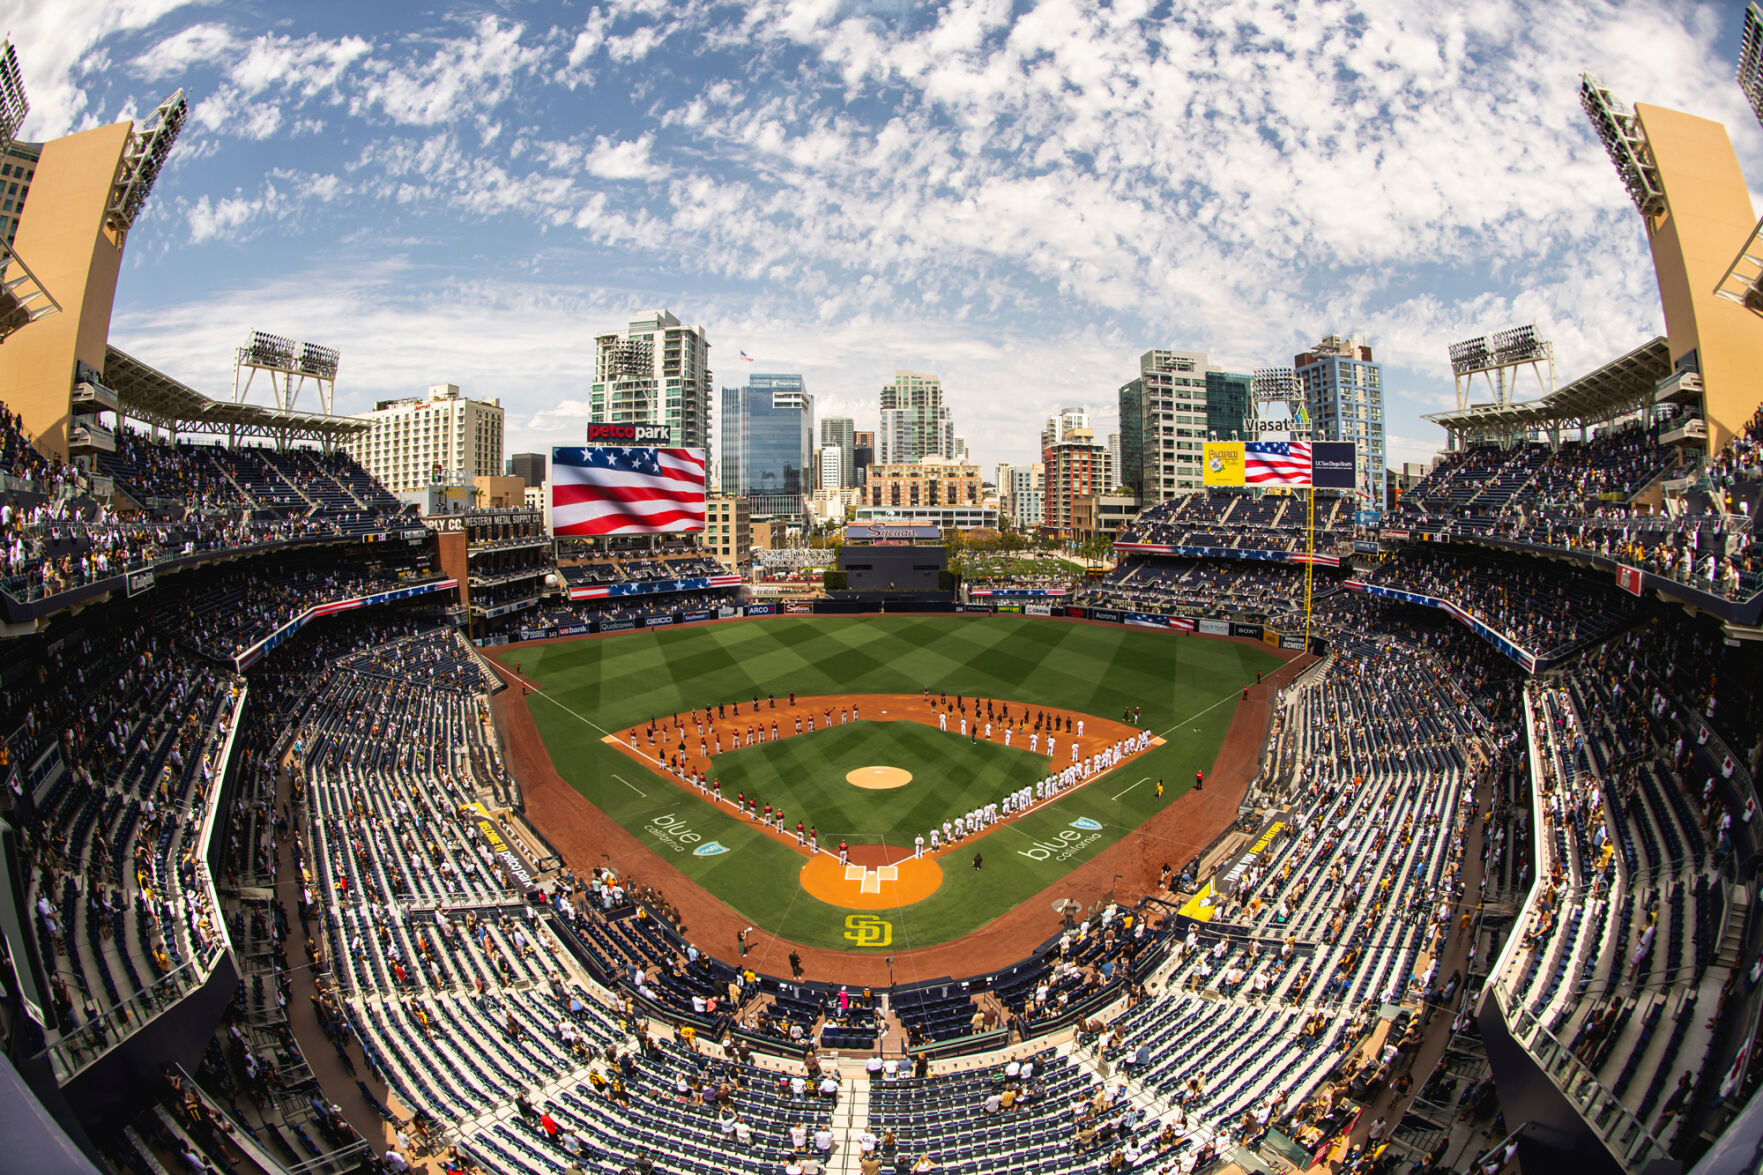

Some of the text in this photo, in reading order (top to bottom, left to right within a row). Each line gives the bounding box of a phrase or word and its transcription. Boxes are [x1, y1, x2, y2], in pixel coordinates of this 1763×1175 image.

[588, 423, 669, 441] petco park
[1246, 418, 1290, 431] Viasat
[448, 518, 464, 531] CO.
[465, 516, 492, 527] WESTERN
[495, 514, 511, 525] METAL
[513, 513, 531, 524] SUPPLY
[866, 523, 918, 541] Sycuan
[749, 606, 768, 614] ARCO
[646, 616, 672, 625] GEICO
[651, 813, 702, 844] blue
[1017, 830, 1082, 862] blue
[1056, 833, 1102, 862] california
